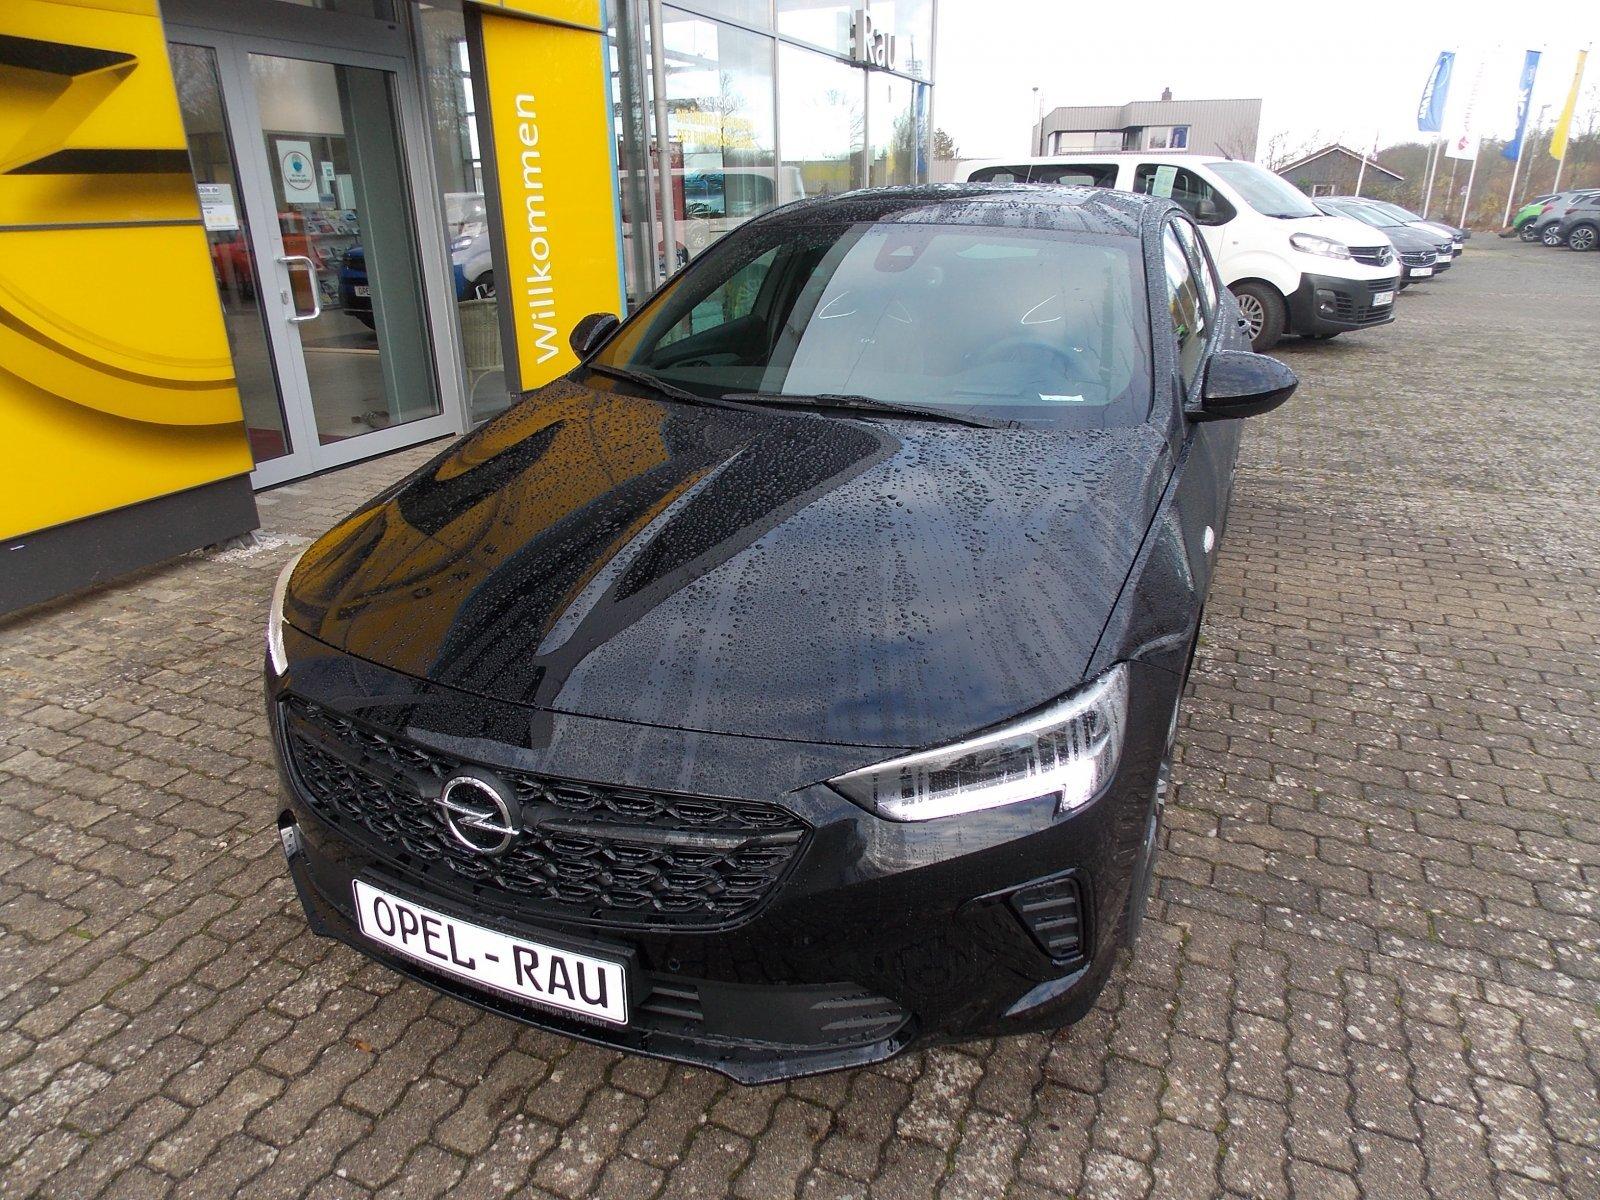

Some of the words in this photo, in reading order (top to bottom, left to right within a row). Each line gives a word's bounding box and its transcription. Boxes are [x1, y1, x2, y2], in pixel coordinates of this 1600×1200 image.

[857, 10, 895, 70] Rau
[515, 93, 559, 364] Willkommen
[373, 896, 475, 970] OPEL
[512, 945, 608, 1008] RAU
